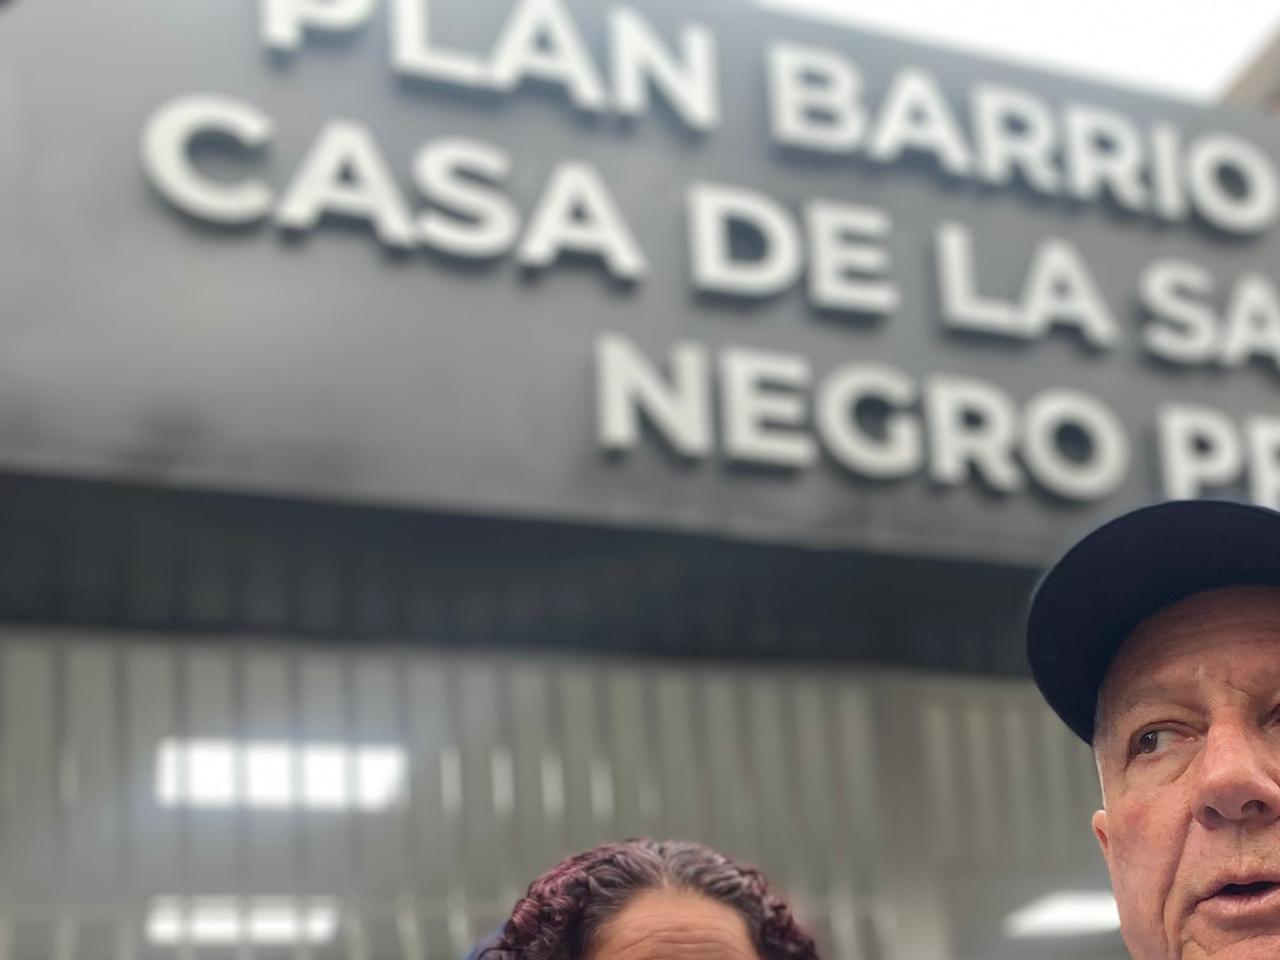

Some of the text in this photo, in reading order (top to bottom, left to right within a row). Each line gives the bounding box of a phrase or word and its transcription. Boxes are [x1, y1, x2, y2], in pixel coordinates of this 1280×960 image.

[141, 95, 645, 281] CASA
[688, 182, 898, 314] DE
[935, 222, 1117, 347] LA
[597, 332, 1131, 500] NEGRO
